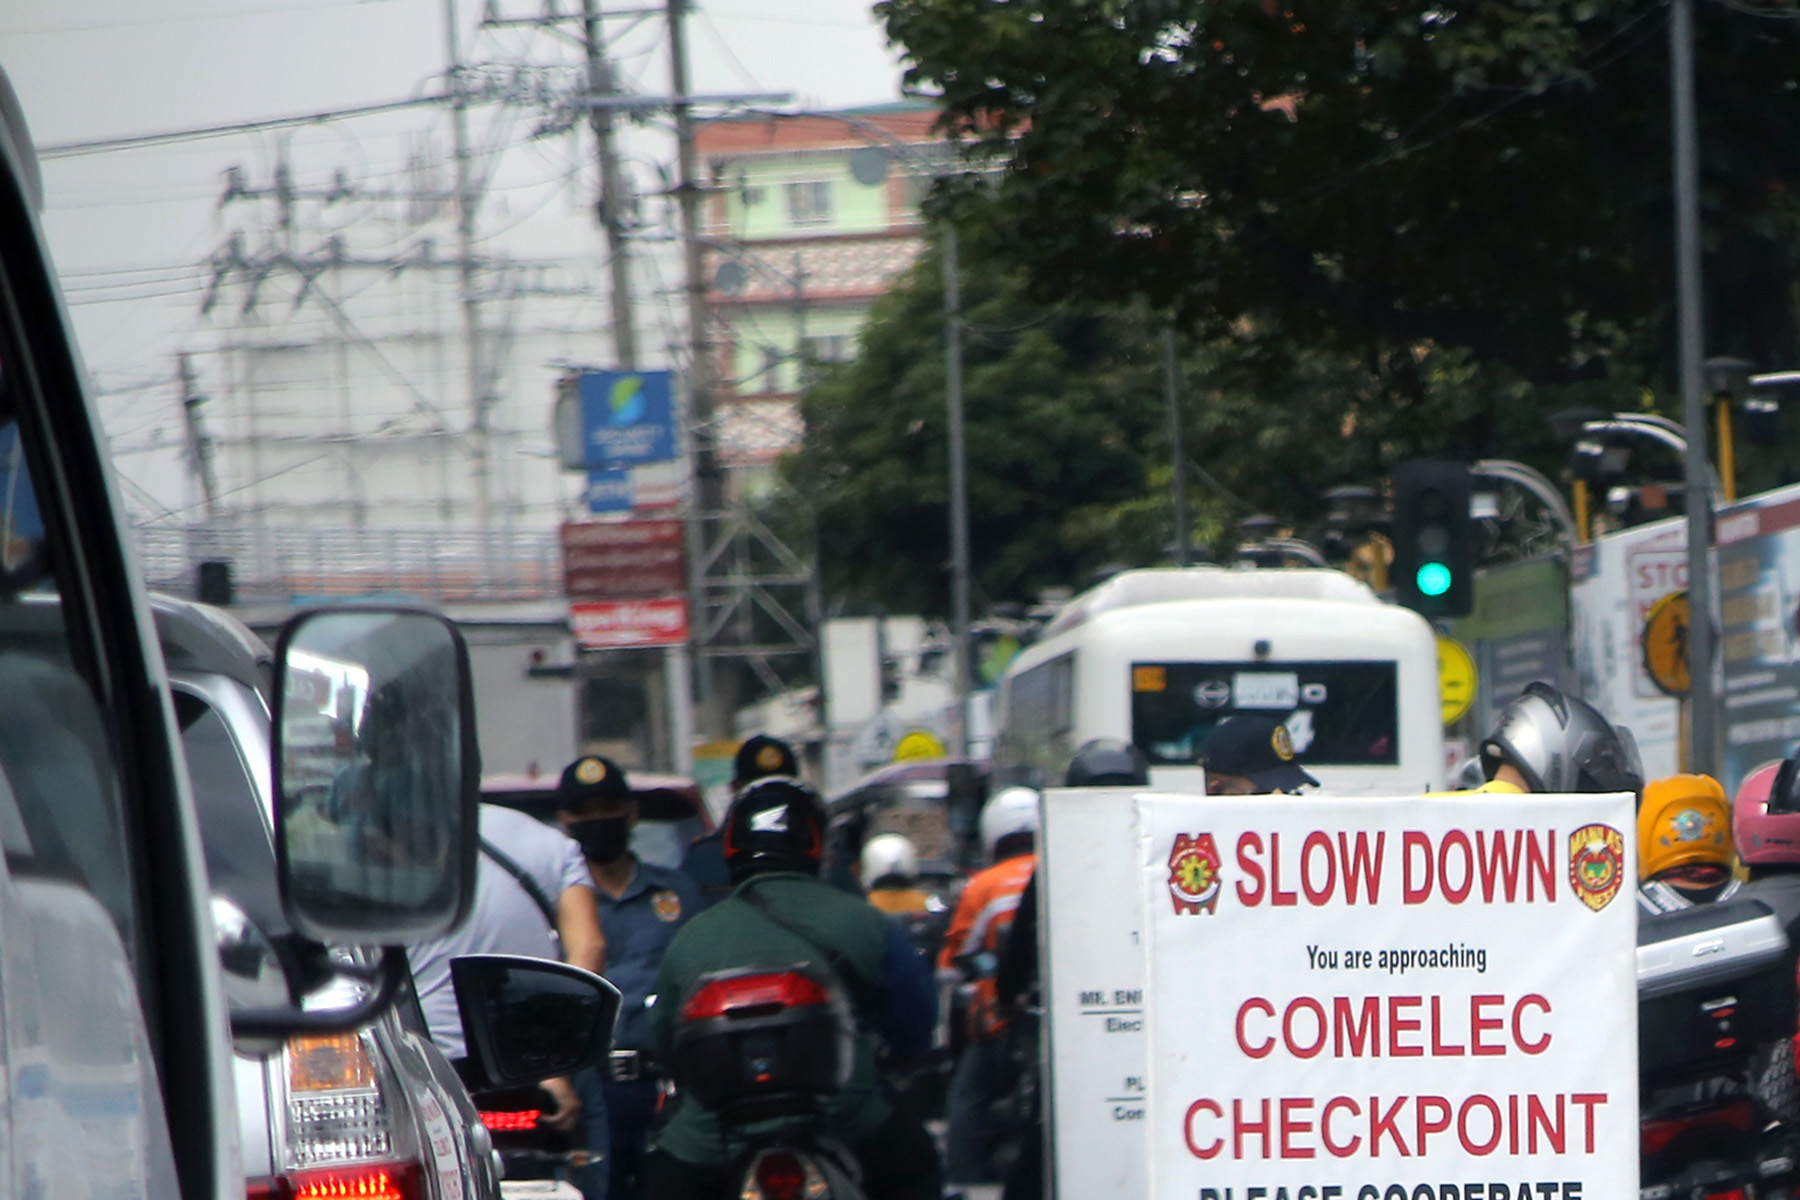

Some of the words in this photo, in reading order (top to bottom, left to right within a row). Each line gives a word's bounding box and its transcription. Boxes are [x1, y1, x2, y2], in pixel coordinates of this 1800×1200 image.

[1236, 831, 1385, 907] SLOW
[1403, 829, 1556, 905] DOWN
[1307, 945, 1339, 970] You
[1344, 950, 1371, 968] are
[1378, 943, 1487, 974] approaching
[1236, 994, 1552, 1059] COMELEC
[1184, 1093, 1607, 1159] CHECKPOINT
